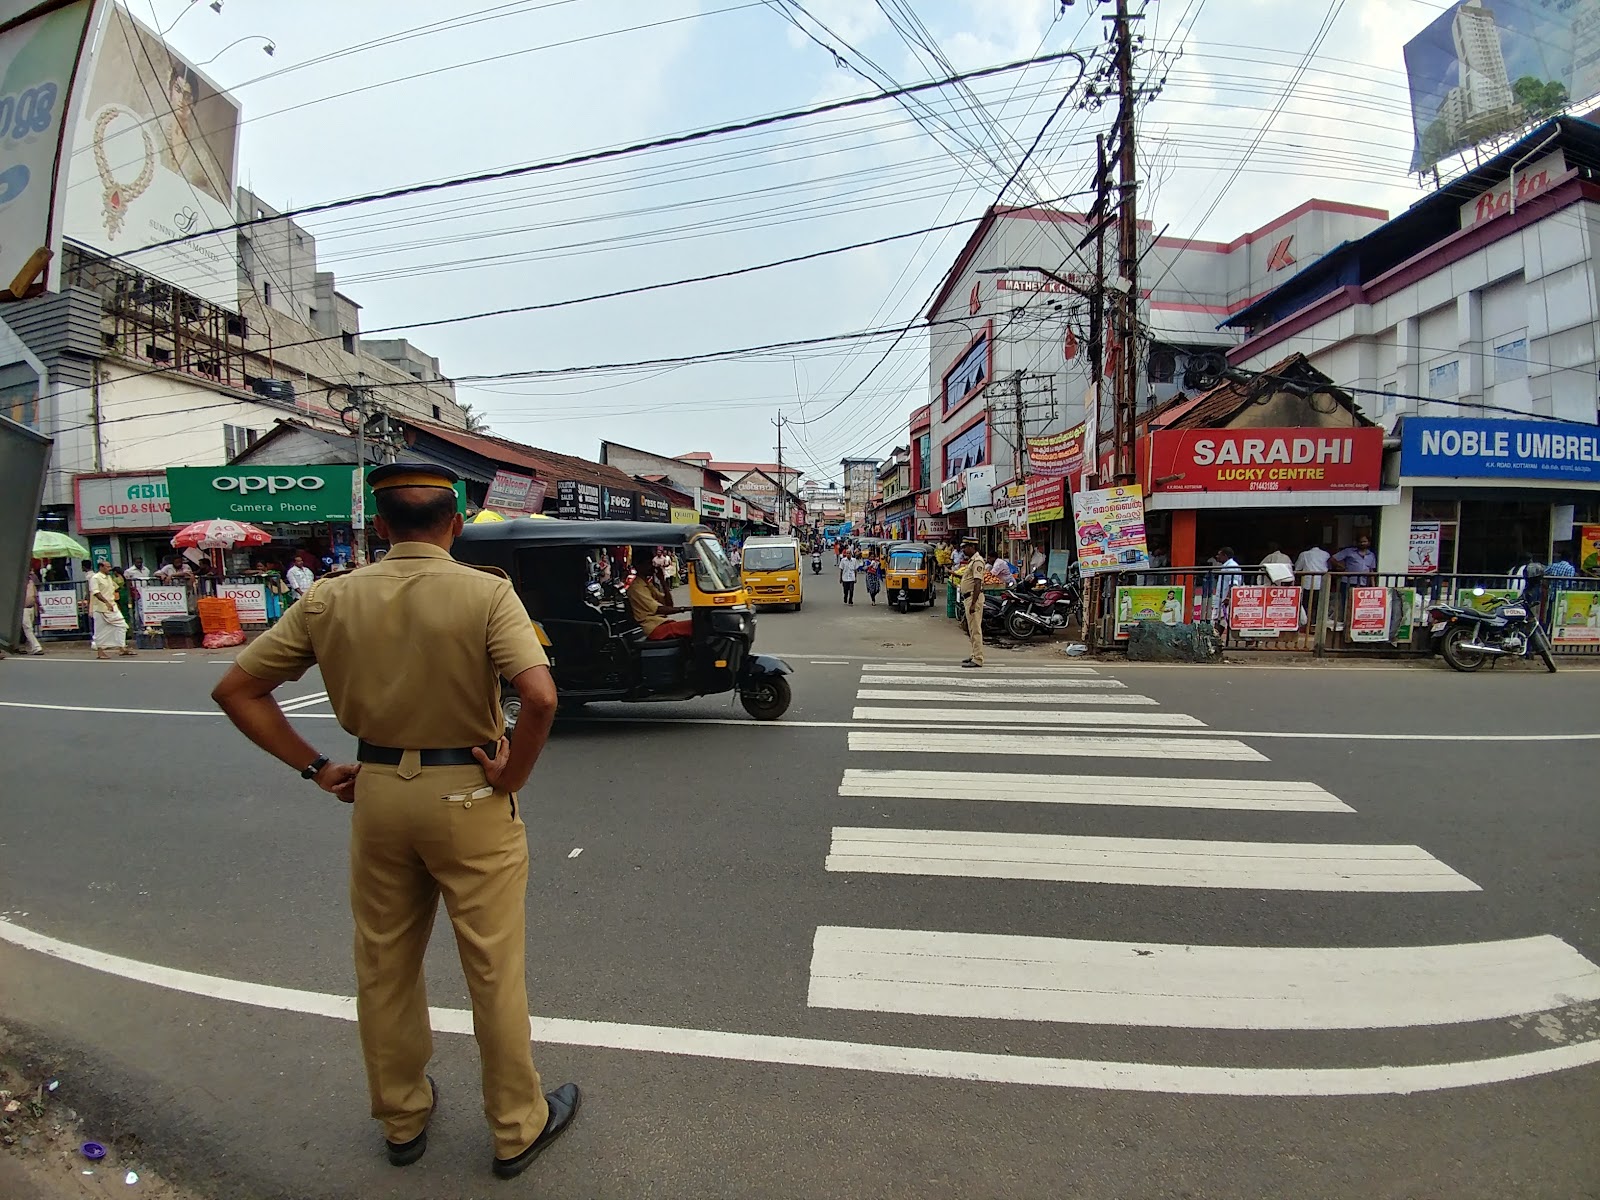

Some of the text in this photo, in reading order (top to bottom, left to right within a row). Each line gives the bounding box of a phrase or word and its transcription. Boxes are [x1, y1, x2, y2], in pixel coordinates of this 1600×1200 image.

[148, 219, 175, 239] SUNNY
[179, 235, 220, 263] DAMONDS
[1421, 430, 1600, 461] NOBLE UMBREL
[1193, 438, 1354, 466] SARADHI
[1217, 467, 1325, 481] LUCKY CENTRE
[578, 484, 598, 497] SOLUTION
[1249, 481, 1279, 491] 8714431826
[127, 483, 169, 500] ABIL
[610, 495, 631, 508] FOGZ
[657, 500, 669, 510] code
[98, 504, 128, 515] GOLD
[130, 503, 139, 513] &
[230, 502, 317, 512] Camera Phone
[146, 592, 182, 601] JOSCO
[224, 590, 261, 599] JOSCO
[1236, 589, 1253, 598] CPI
[1270, 589, 1287, 598] CPI
[1357, 590, 1374, 599] CPI
[44, 596, 73, 606] JOSCO
